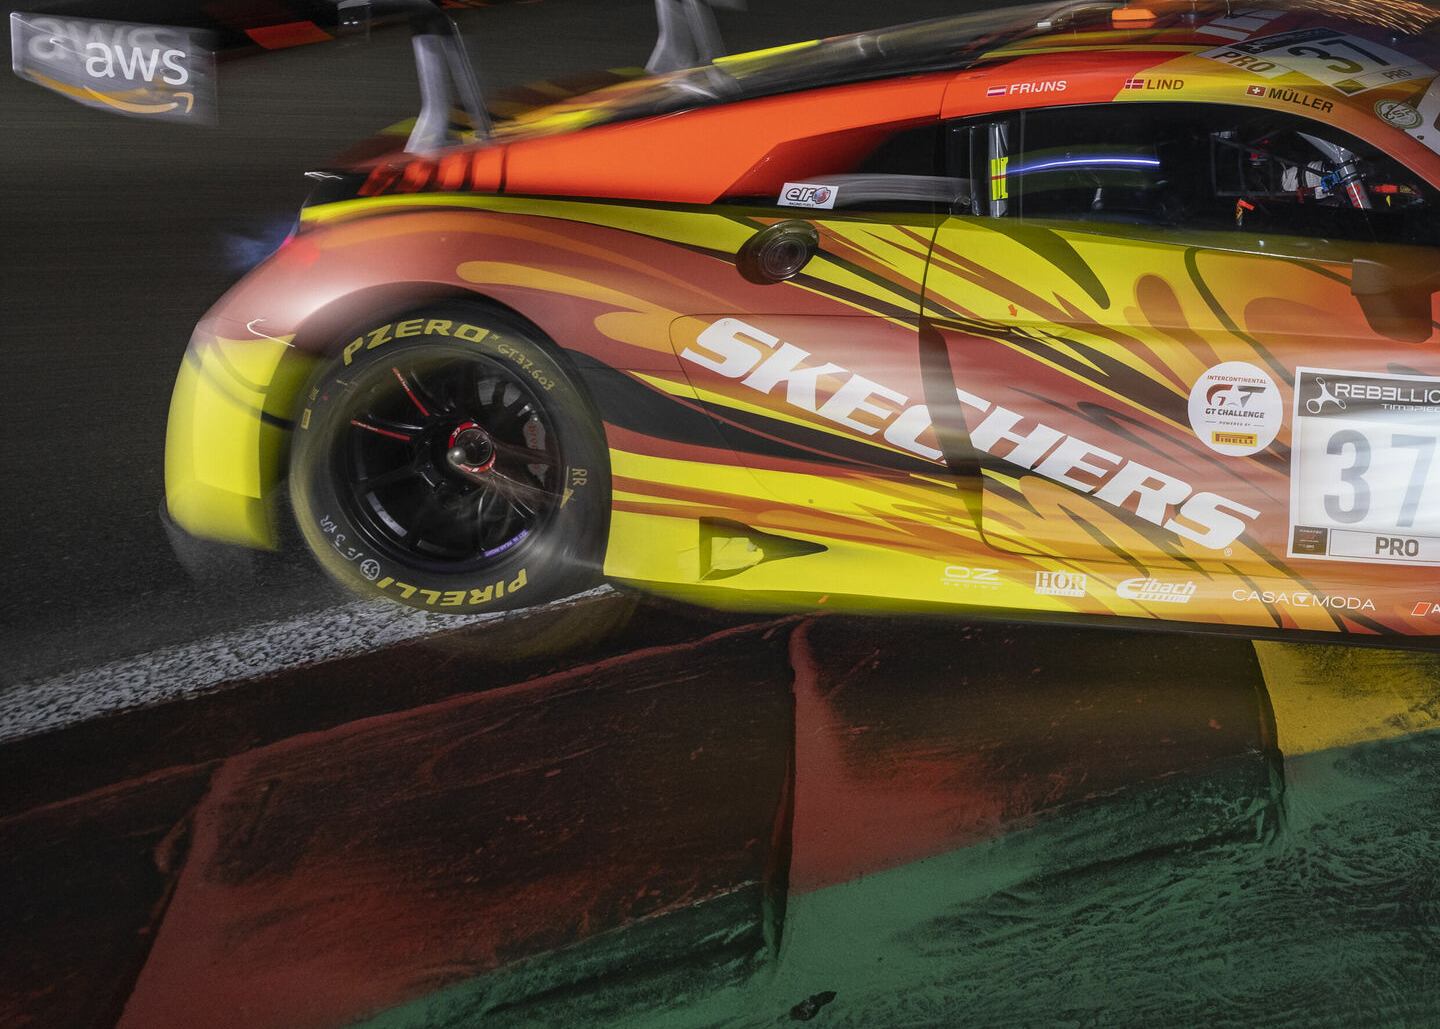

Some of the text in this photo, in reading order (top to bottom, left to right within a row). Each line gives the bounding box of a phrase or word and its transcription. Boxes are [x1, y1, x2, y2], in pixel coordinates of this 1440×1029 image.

[85, 42, 189, 86] aws
[1211, 51, 1276, 72] PRO
[1287, 38, 1391, 73] 37
[1009, 80, 1067, 95] FRIJNS
[1146, 79, 1184, 90] LIND
[1268, 87, 1334, 113] MÜLLER
[785, 187, 816, 202] elf
[497, 343, 556, 391] GT.37.603
[1207, 375, 1267, 384] INTERCONTINENTAL
[1217, 409, 1265, 419] CHALLENGE
[680, 317, 1261, 551] SKECHERS
[1215, 433, 1254, 445] PIRELLI
[571, 468, 588, 486] RR
[1323, 429, 1437, 528] 37
[1375, 536, 1420, 557] PRO
[375, 568, 528, 607] PIRELLI
[1037, 569, 1085, 590] HÖR
[1116, 577, 1197, 599] Eibach
[1231, 589, 1376, 611] CASA MODA
